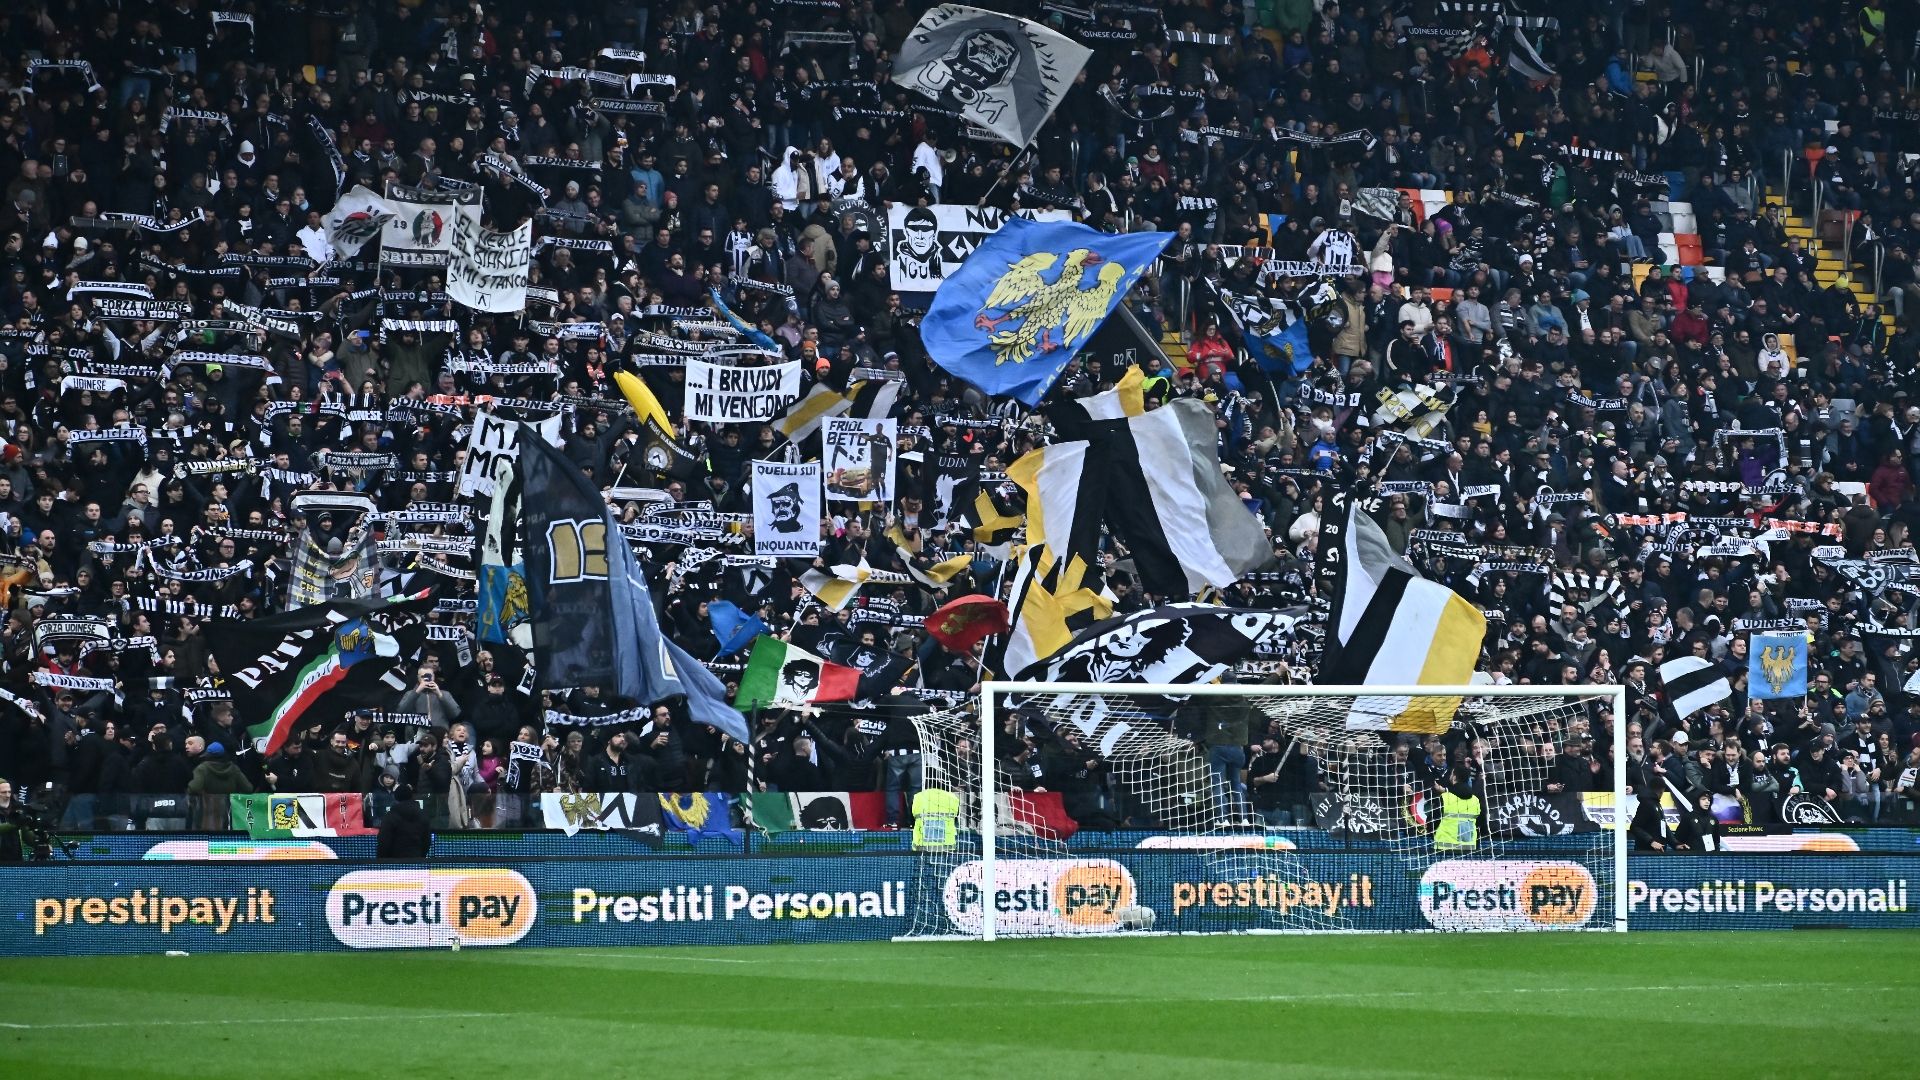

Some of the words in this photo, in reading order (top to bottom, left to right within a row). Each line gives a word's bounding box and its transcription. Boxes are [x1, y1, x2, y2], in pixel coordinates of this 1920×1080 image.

[1408, 27, 1438, 36] UDINESE
[613, 48, 641, 59] UDINESE
[410, 90, 476, 106] UDINESE
[600, 101, 625, 110] FORZA
[626, 103, 659, 113] UDINESE
[536, 156, 595, 169] UDINESE
[549, 237, 607, 250] UDINESE
[257, 256, 285, 265] NORD
[474, 243, 529, 269] BIANCO
[478, 272, 528, 289] STANCO
[101, 298, 137, 311] FORZA
[141, 300, 188, 312] UDINESE
[657, 304, 711, 316] UDINES
[102, 307, 146, 318] TEDDY
[650, 336, 675, 348] FORZA
[1113, 353, 1125, 366] D2
[102, 367, 158, 378] SEGUITO
[472, 364, 489, 372] AL
[493, 365, 547, 373] SEGUITO
[74, 377, 107, 391] UDINESE
[719, 367, 782, 392] BRIVIDI
[501, 398, 573, 412] UDINESE
[694, 392, 714, 418] MI
[826, 432, 870, 447] BETO
[188, 457, 248, 471] UDINESE
[327, 455, 352, 465] FORZA
[360, 456, 389, 466] UDINESE
[757, 465, 798, 477] QUELLI
[800, 466, 817, 477] SUI
[1536, 492, 1584, 505] UDINESE
[1325, 525, 1339, 535] 20
[1417, 530, 1461, 543] DINESE
[757, 540, 819, 553] INQUANTA
[1711, 545, 1740, 556] UDINESE
[1729, 538, 1759, 550] UDINESE
[1817, 546, 1841, 557] UDINESE
[1870, 546, 1913, 558] UDINESE
[180, 565, 241, 581] UDINESE
[1489, 562, 1545, 573] UDINESE
[40, 623, 62, 634] FORZA
[65, 624, 96, 634] UDINESE
[1743, 618, 1801, 630] UDINESE
[50, 674, 103, 691] UDINESE
[1334, 792, 1360, 804] NS
[1727, 825, 1748, 833] Sezione
[573, 884, 713, 923] Prestiti
[725, 880, 906, 920] Personali
[1065, 883, 1123, 916] pay
[1173, 873, 1374, 917] prestipay.it
[1432, 880, 1516, 912] Presti
[1531, 883, 1584, 915] pay
[1628, 879, 1745, 914] Prestiti
[1755, 879, 1907, 914] Personali
[35, 887, 276, 935] prestipay.it
[342, 892, 441, 926] Presti
[458, 894, 521, 928] pay
